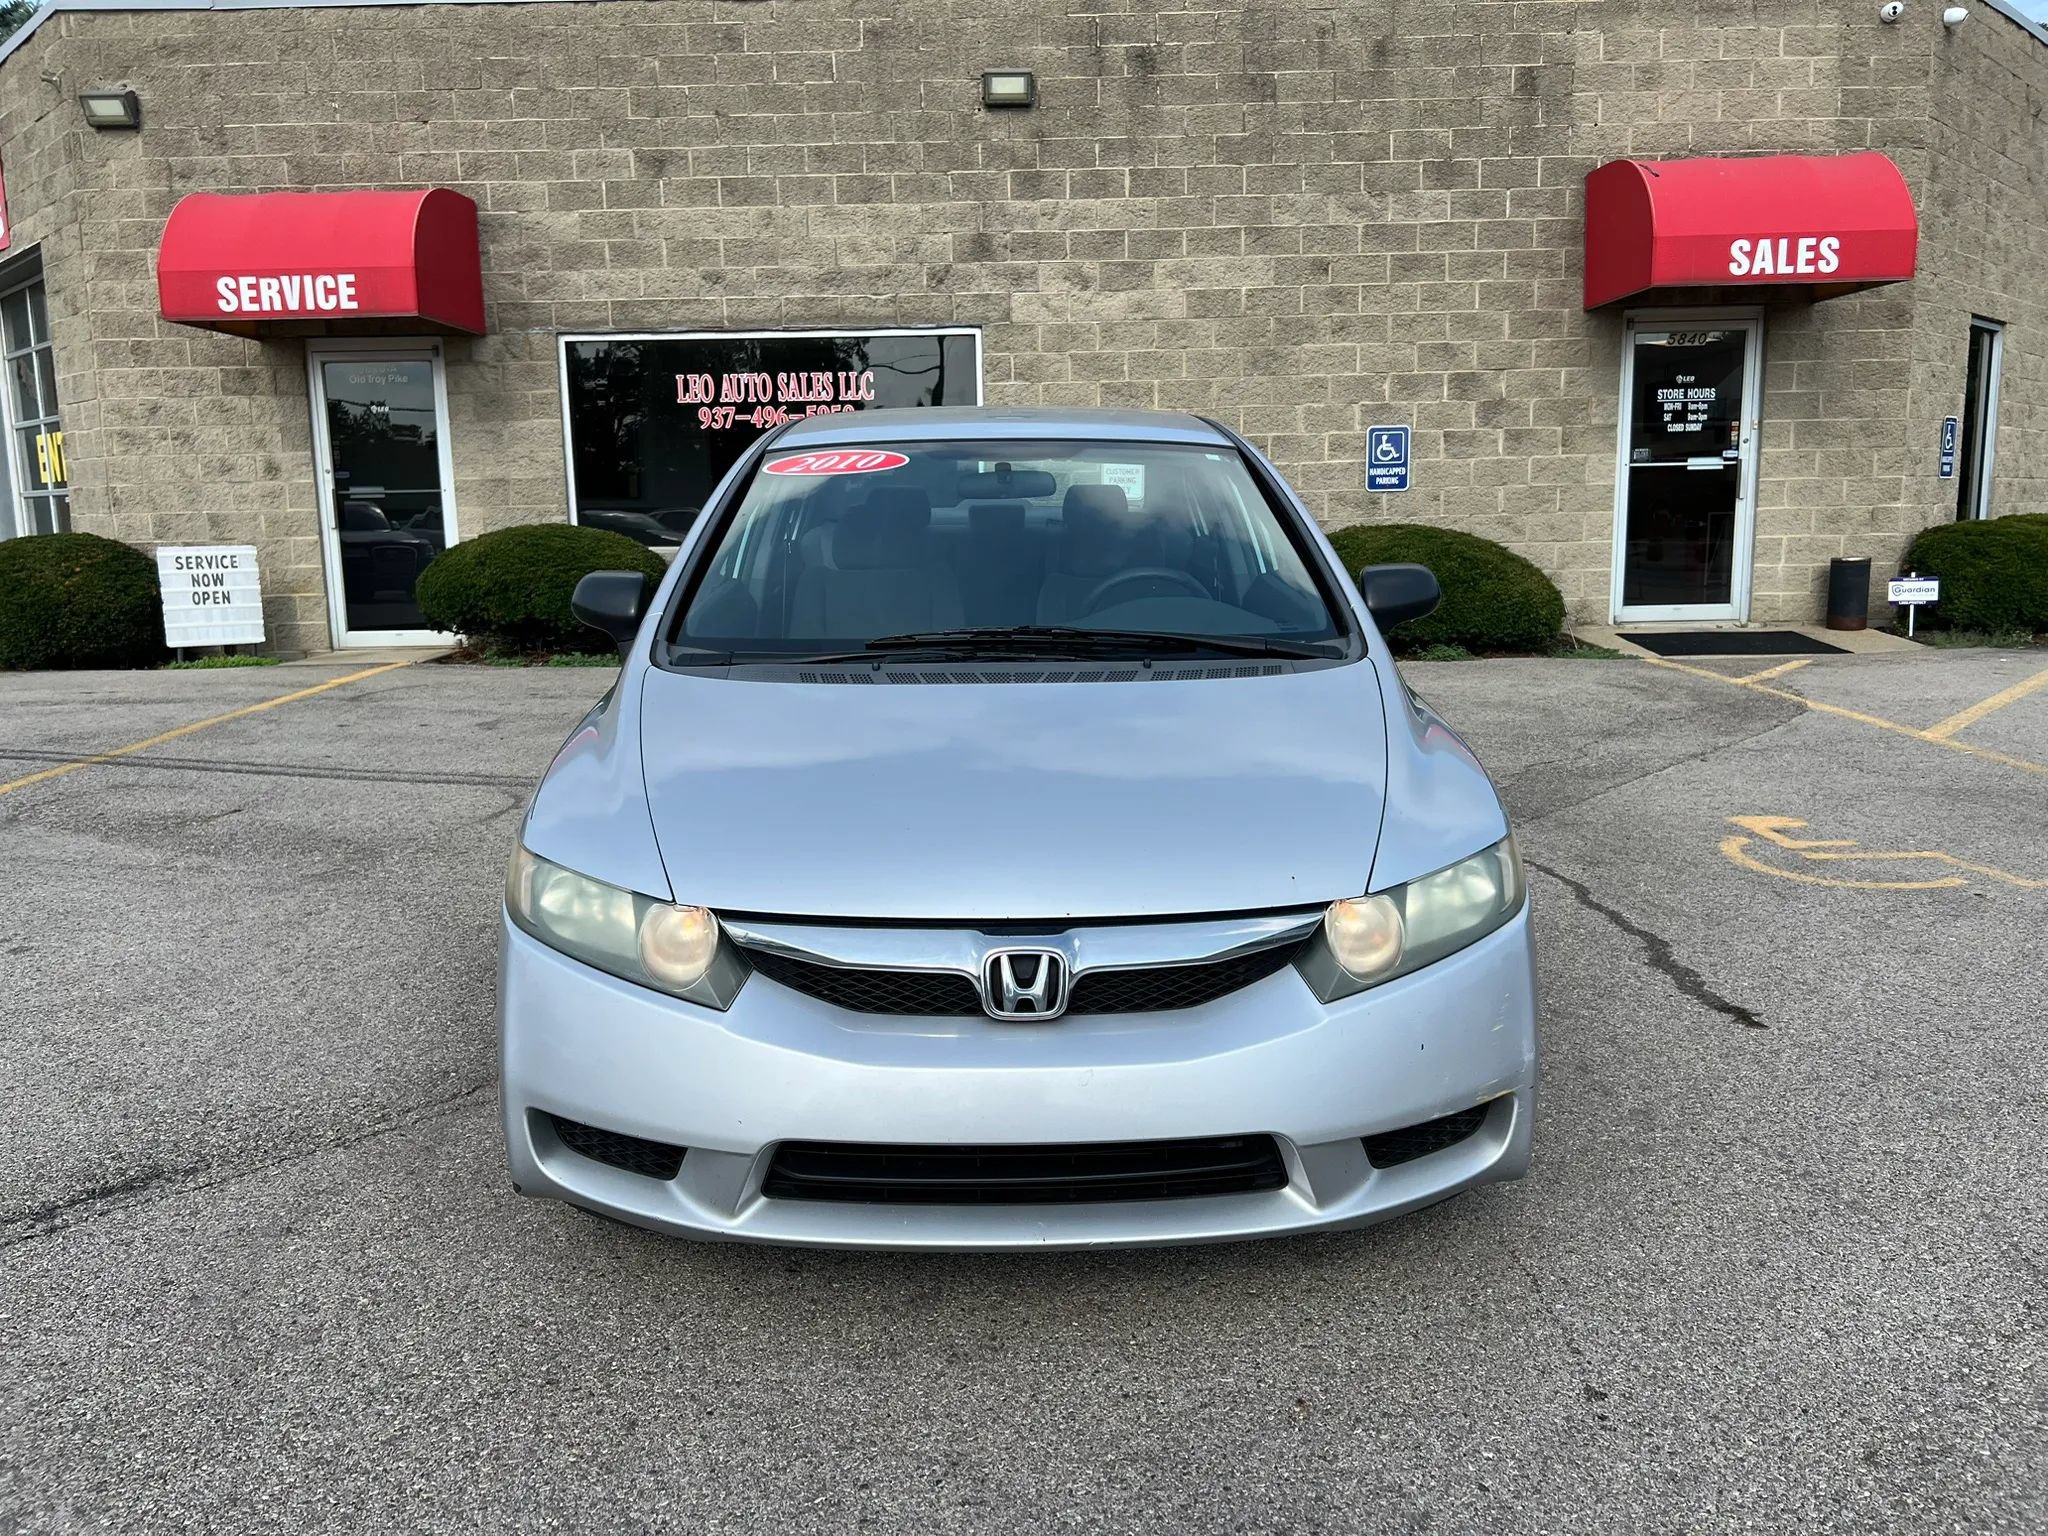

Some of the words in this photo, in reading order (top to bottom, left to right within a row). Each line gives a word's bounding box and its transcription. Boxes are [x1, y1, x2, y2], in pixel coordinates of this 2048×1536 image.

[1729, 236, 1840, 276] SALES
[216, 273, 359, 313] SERVICE
[1667, 332, 1707, 346] 5840
[676, 374, 715, 403] LEO
[720, 373, 773, 402] AUTO
[777, 371, 833, 401] SALES
[837, 371, 875, 400] LLC
[1657, 388, 1685, 400] STORE
[1687, 388, 1716, 399] HOURS
[1667, 423, 1685, 432] CLOSED
[784, 453, 887, 473] 2010
[1369, 467, 1406, 476] HANDICAPPED
[1374, 476, 1400, 485] PARKING
[175, 555, 239, 570] SERVICE
[191, 573, 224, 588] NOW
[1893, 585, 1936, 594] Guardian
[192, 590, 231, 605] OPEN
